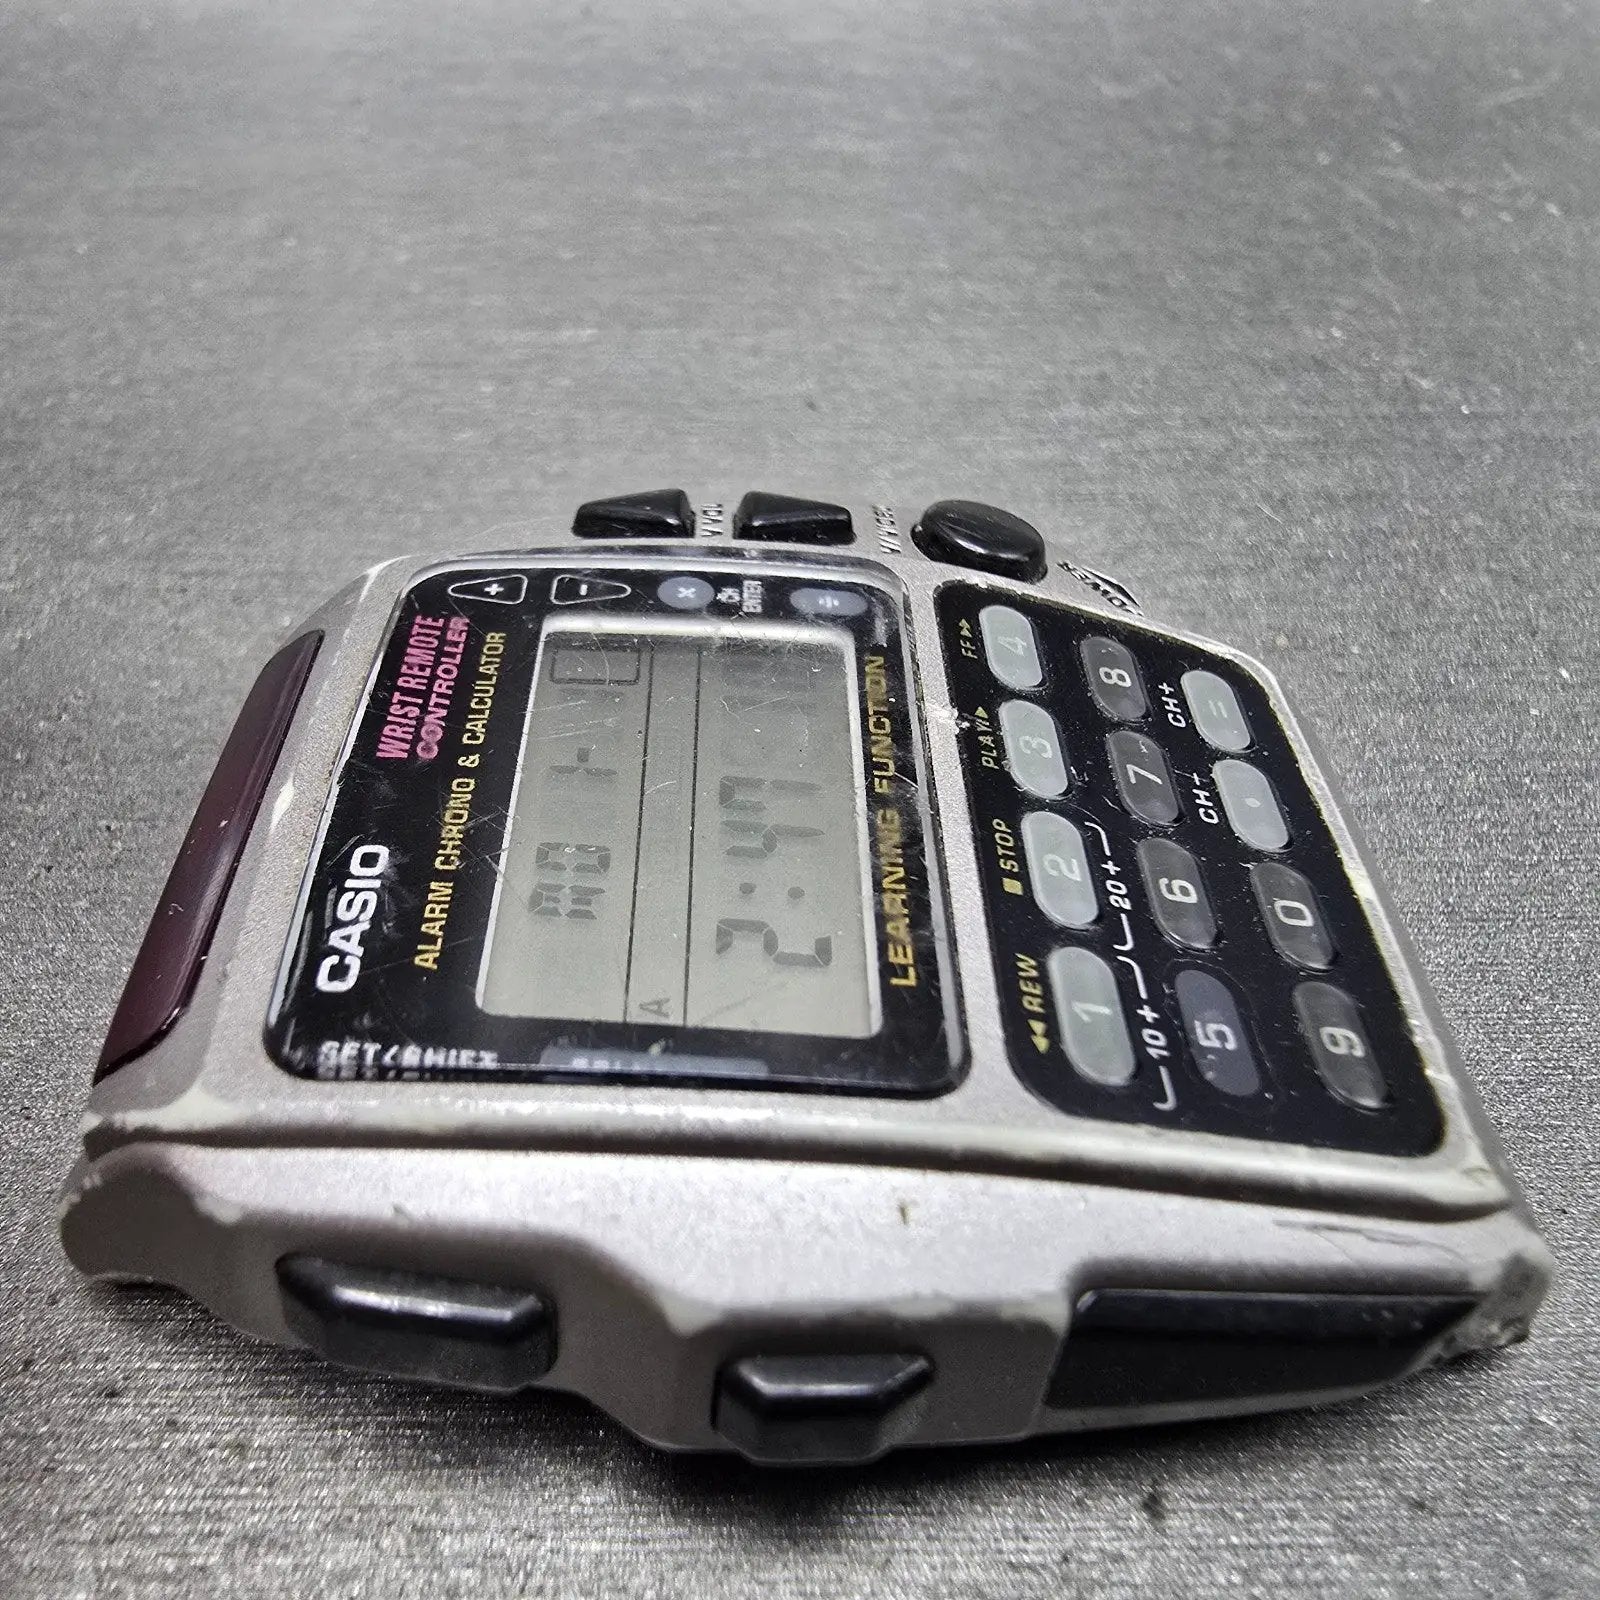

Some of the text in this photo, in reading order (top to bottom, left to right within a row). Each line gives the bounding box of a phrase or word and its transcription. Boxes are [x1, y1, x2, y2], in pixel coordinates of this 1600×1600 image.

[961, 639, 978, 659] FF
[998, 634, 1027, 655] 4
[376, 614, 446, 760] WRIST REMOTE
[416, 616, 471, 761] CONTROLLER
[1099, 667, 1132, 688] 8
[1158, 681, 1187, 728] CH+
[1019, 735, 1053, 759] 3
[1126, 764, 1162, 785] 7
[414, 632, 508, 971] ALARM CHRONO & CALCULATOR
[865, 656, 917, 988] LEARNING FUNCTION
[991, 818, 1016, 873] STOP
[1043, 853, 1082, 882] 2
[1160, 877, 1198, 904] 6
[316, 844, 390, 993] CASIO
[1274, 899, 1315, 928] 0
[1015, 953, 1047, 1014] REW
[639, 998, 671, 1018] A
[1072, 1003, 1112, 1024] 1
[1198, 1020, 1237, 1051] 5
[1320, 1026, 1365, 1058] 9
